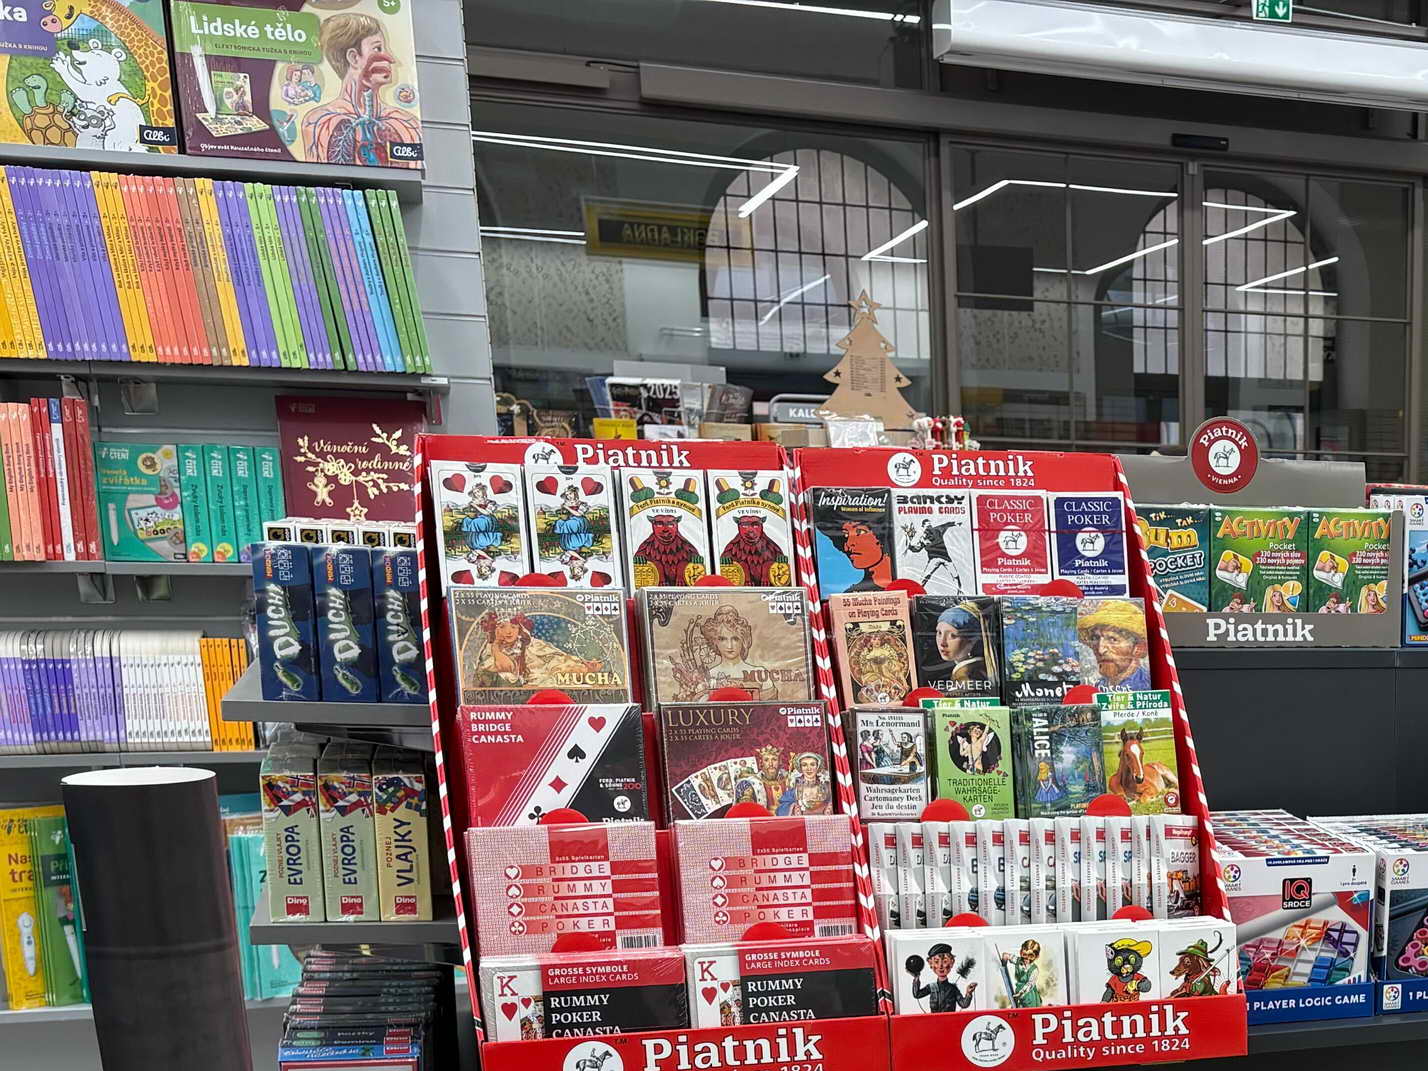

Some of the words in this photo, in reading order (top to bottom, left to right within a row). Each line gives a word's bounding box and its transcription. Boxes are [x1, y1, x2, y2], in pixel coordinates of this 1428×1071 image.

[190, 16, 259, 39] Lidské
[265, 23, 307, 42] tělo
[313, 438, 369, 455] Vánoční
[357, 457, 412, 473] rodinné
[574, 444, 692, 469] Piatnik
[931, 453, 1034, 477] Piatnik
[932, 477, 973, 487] Quality
[977, 478, 1006, 486] since
[1010, 478, 1035, 487] 1824
[818, 494, 888, 511] Inspiration!
[986, 499, 1034, 510] CLASSIC
[1064, 501, 1112, 512] CLASSIC
[990, 513, 1033, 523] POKER
[1068, 515, 1112, 525] POKER
[1216, 516, 1301, 540] ACTIVITY
[1269, 542, 1296, 550] Pocket
[1206, 618, 1314, 641] Piatnik
[557, 671, 623, 686] MUCHA
[927, 680, 992, 690] VERMEER
[1107, 693, 1125, 701] Tier
[470, 712, 513, 721] RUMMY
[667, 708, 754, 727] LUXURY
[471, 723, 511, 733] BRIDGE
[472, 734, 524, 743] CANASTA
[1033, 717, 1051, 759] ALICE
[948, 778, 1006, 787] TRADITIONELLE
[955, 787, 1000, 795] WAHRSAGE-
[286, 824, 300, 887] EVROPA
[342, 825, 355, 886] EVROPA
[396, 817, 414, 887] VLAJKY
[535, 863, 606, 877] BRIDGE
[537, 881, 607, 895] RUMMY
[539, 900, 609, 914] CANASTA
[1283, 900, 1311, 908] SRDCE
[745, 952, 780, 961] GROSSE
[783, 949, 821, 959] SYMBOLE
[548, 967, 583, 976] GROSSE
[586, 965, 628, 974] SYMBOLE
[698, 960, 718, 981] K
[745, 961, 773, 970] LARGE
[775, 959, 803, 967] INDEX
[805, 957, 831, 966] CARDS
[747, 978, 803, 992] RUMMY
[551, 994, 609, 1008] RUMMY
[749, 994, 796, 1007] POKER
[1253, 998, 1295, 1011] PLAYER
[1300, 996, 1331, 1008] LOGIC
[1335, 993, 1366, 1005] GAME
[1409, 991, 1413, 999] 1
[552, 1011, 601, 1024] POKER
[749, 1009, 816, 1022] CANASTA
[1031, 1005, 1190, 1045] Piatnik
[642, 1028, 823, 1071] Piatnik
[1032, 1046, 1096, 1061] Quality
[1102, 1043, 1144, 1055] since
[1151, 1038, 1190, 1051] 1824
